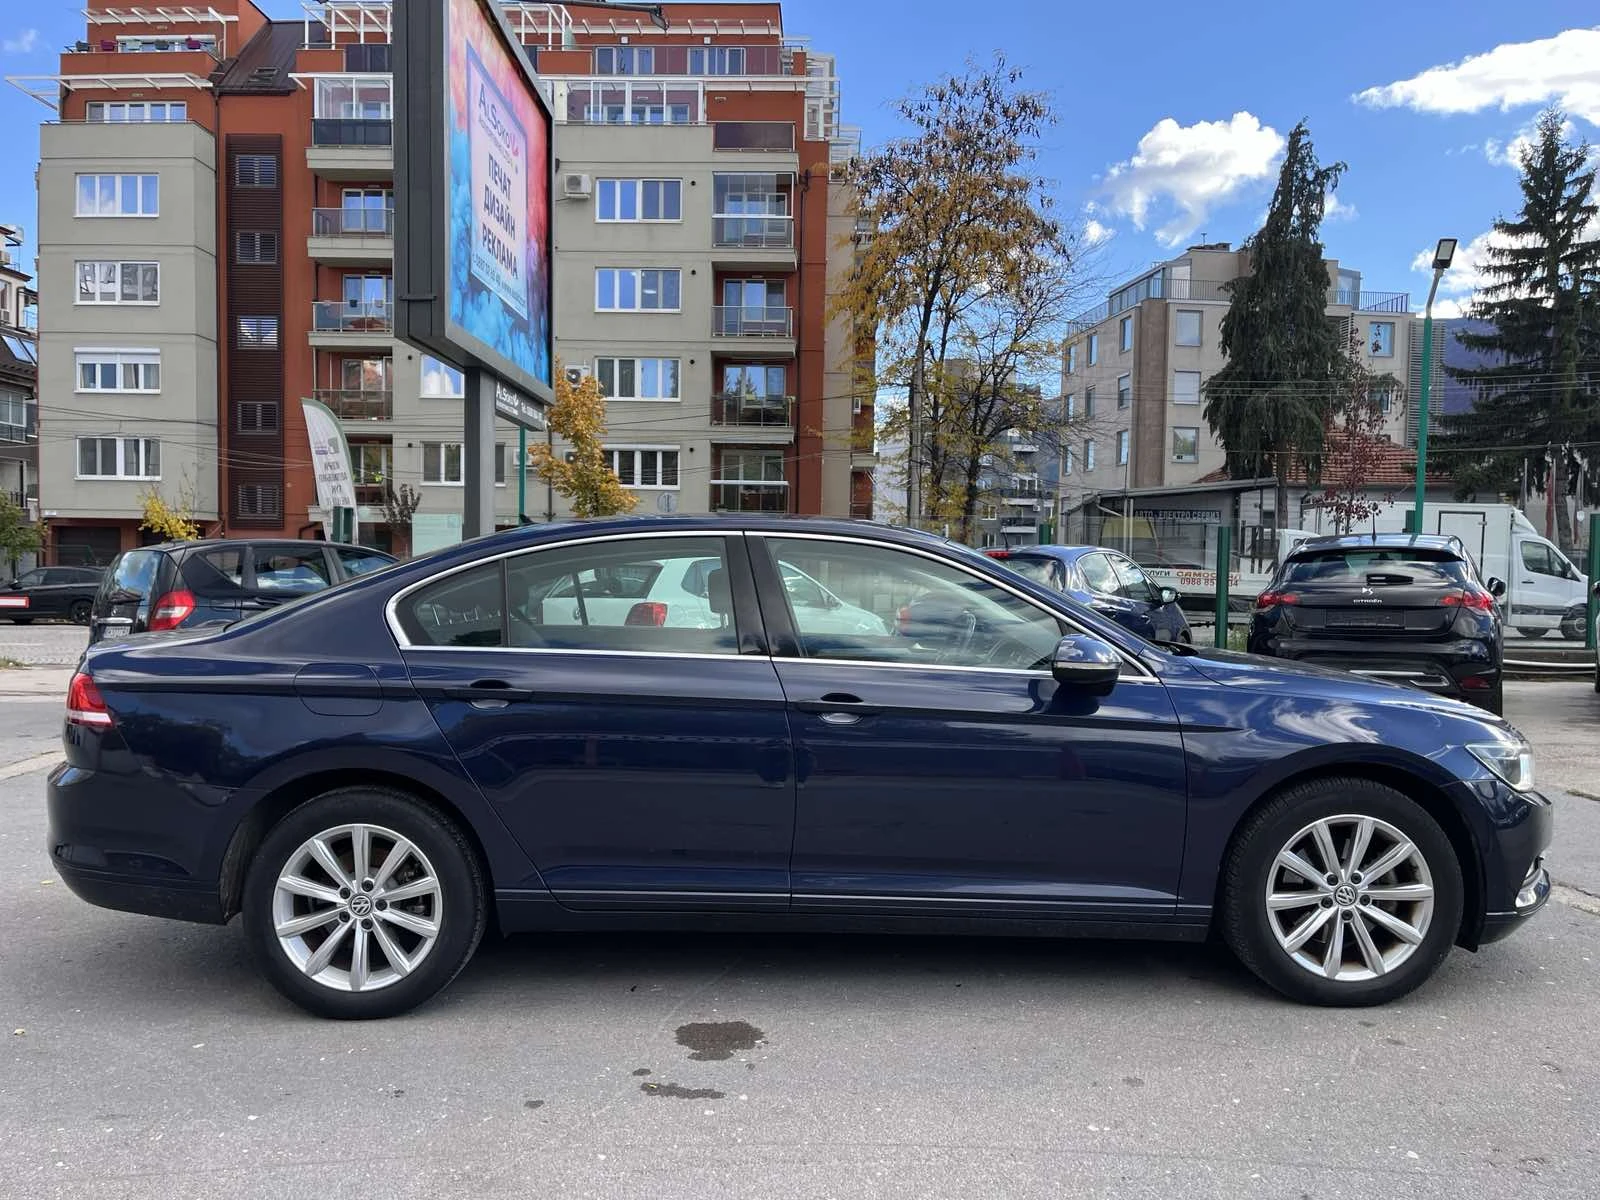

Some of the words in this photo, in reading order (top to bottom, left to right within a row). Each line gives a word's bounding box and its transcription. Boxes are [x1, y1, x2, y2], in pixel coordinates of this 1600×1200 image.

[488, 152, 511, 200] ПЕЧАТ
[484, 184, 516, 241] ДИЗАЙН
[482, 222, 518, 280] РЕКЛАМА
[1180, 578, 1201, 586] 0988
